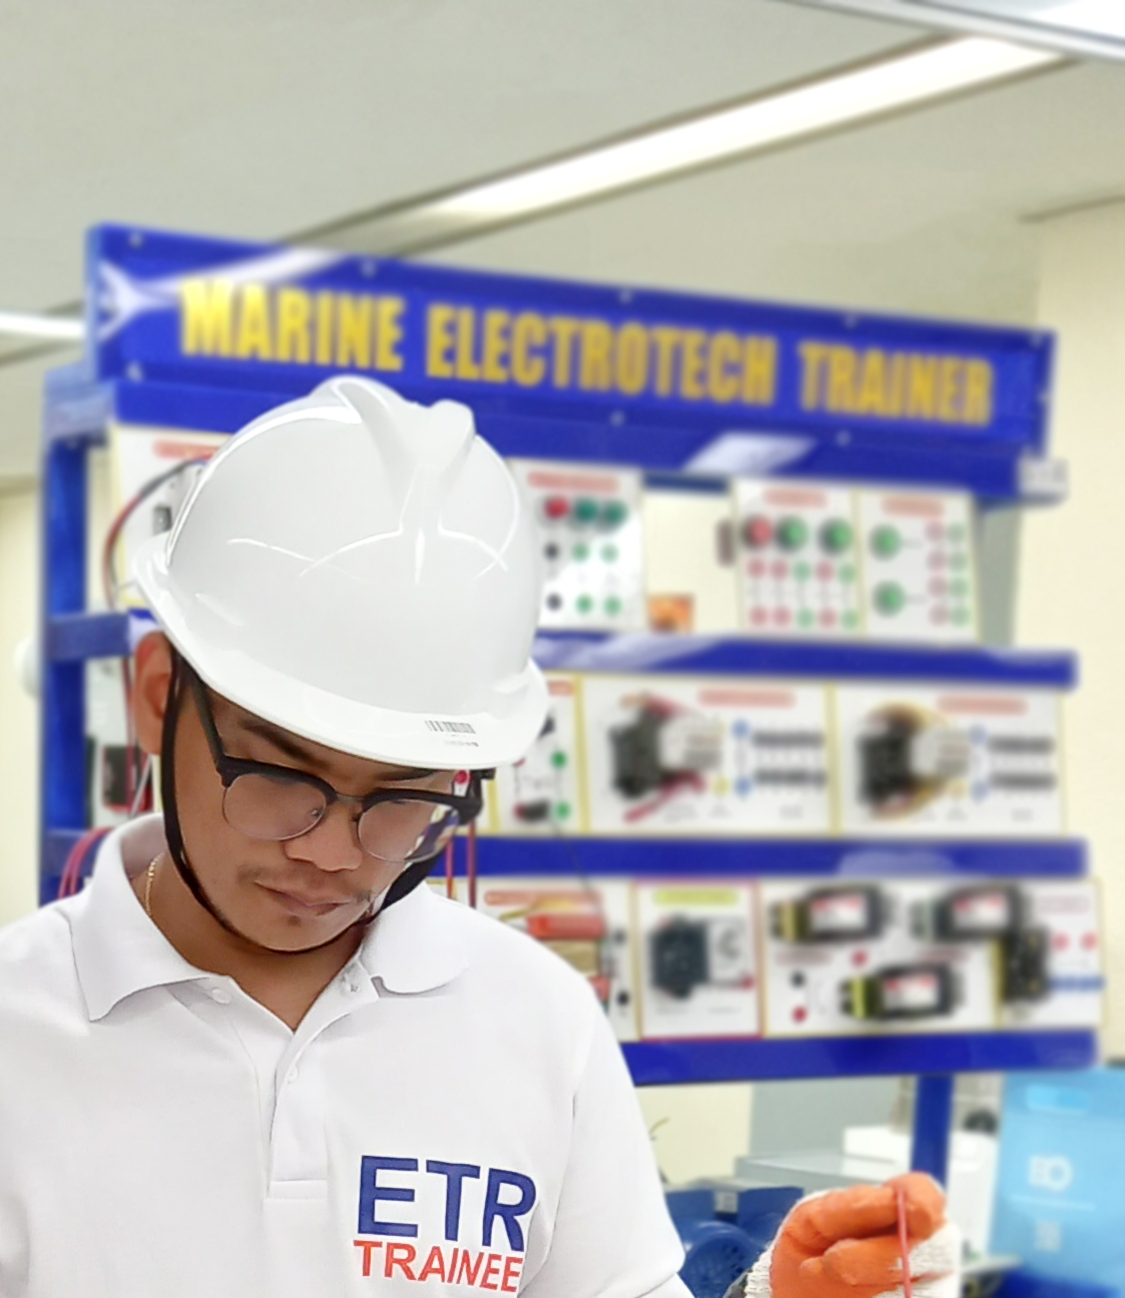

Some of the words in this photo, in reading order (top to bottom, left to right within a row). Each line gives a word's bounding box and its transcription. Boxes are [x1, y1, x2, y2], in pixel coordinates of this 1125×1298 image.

[181, 278, 405, 372] MARINE
[425, 303, 776, 408] ELECTROTECH
[799, 340, 994, 426] TRAINER
[357, 1154, 536, 1253] ETR
[353, 1240, 525, 1293] TRAINEE
